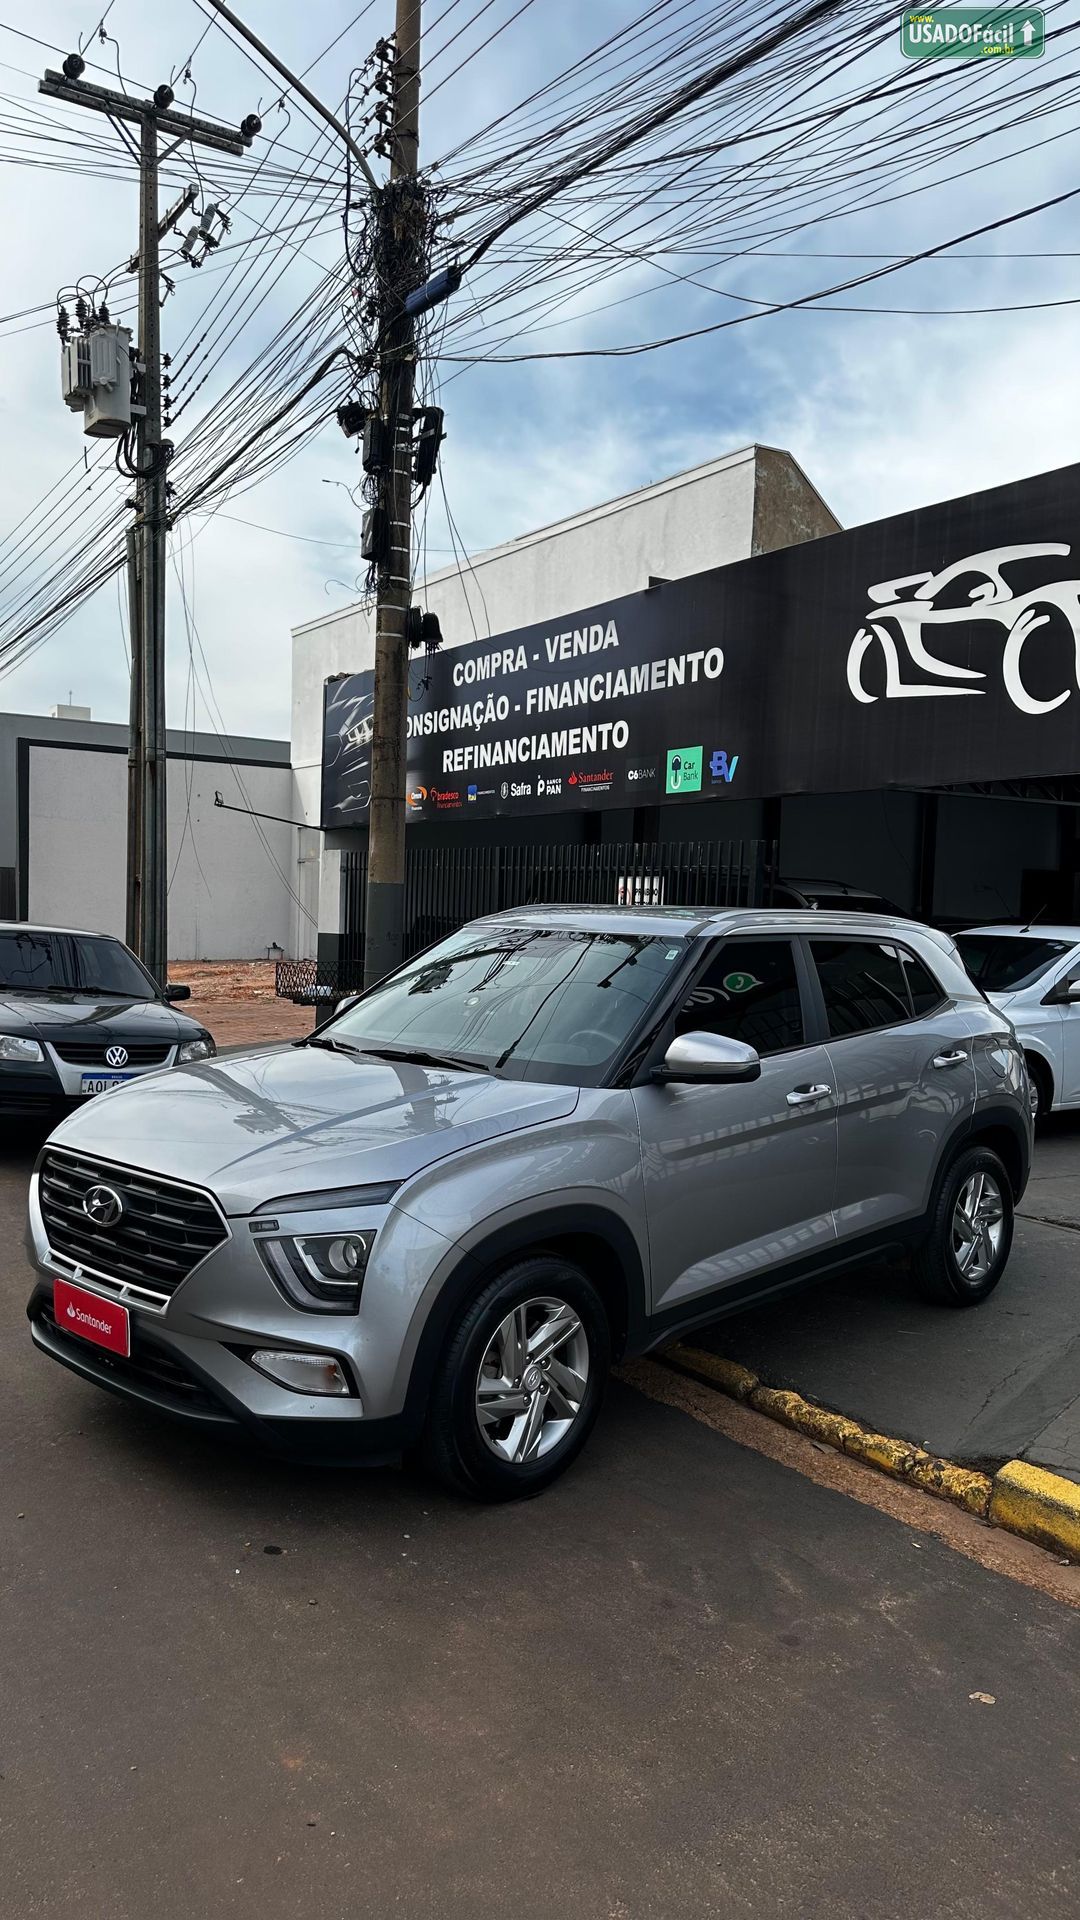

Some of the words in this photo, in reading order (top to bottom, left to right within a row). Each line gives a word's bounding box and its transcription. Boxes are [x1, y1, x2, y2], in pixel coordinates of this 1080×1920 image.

[453, 645, 528, 687] COMPRA
[545, 620, 619, 663] VENDA
[526, 647, 725, 715] FINANCIAMENTO
[442, 720, 629, 773] REFINANCIAMENTO
[684, 761, 695, 769] Car
[578, 769, 614, 783] Santander
[683, 770, 698, 780] Bank
[510, 782, 532, 797] Safra
[546, 784, 562, 795] PAN
[76, 1308, 112, 1334] Santander
